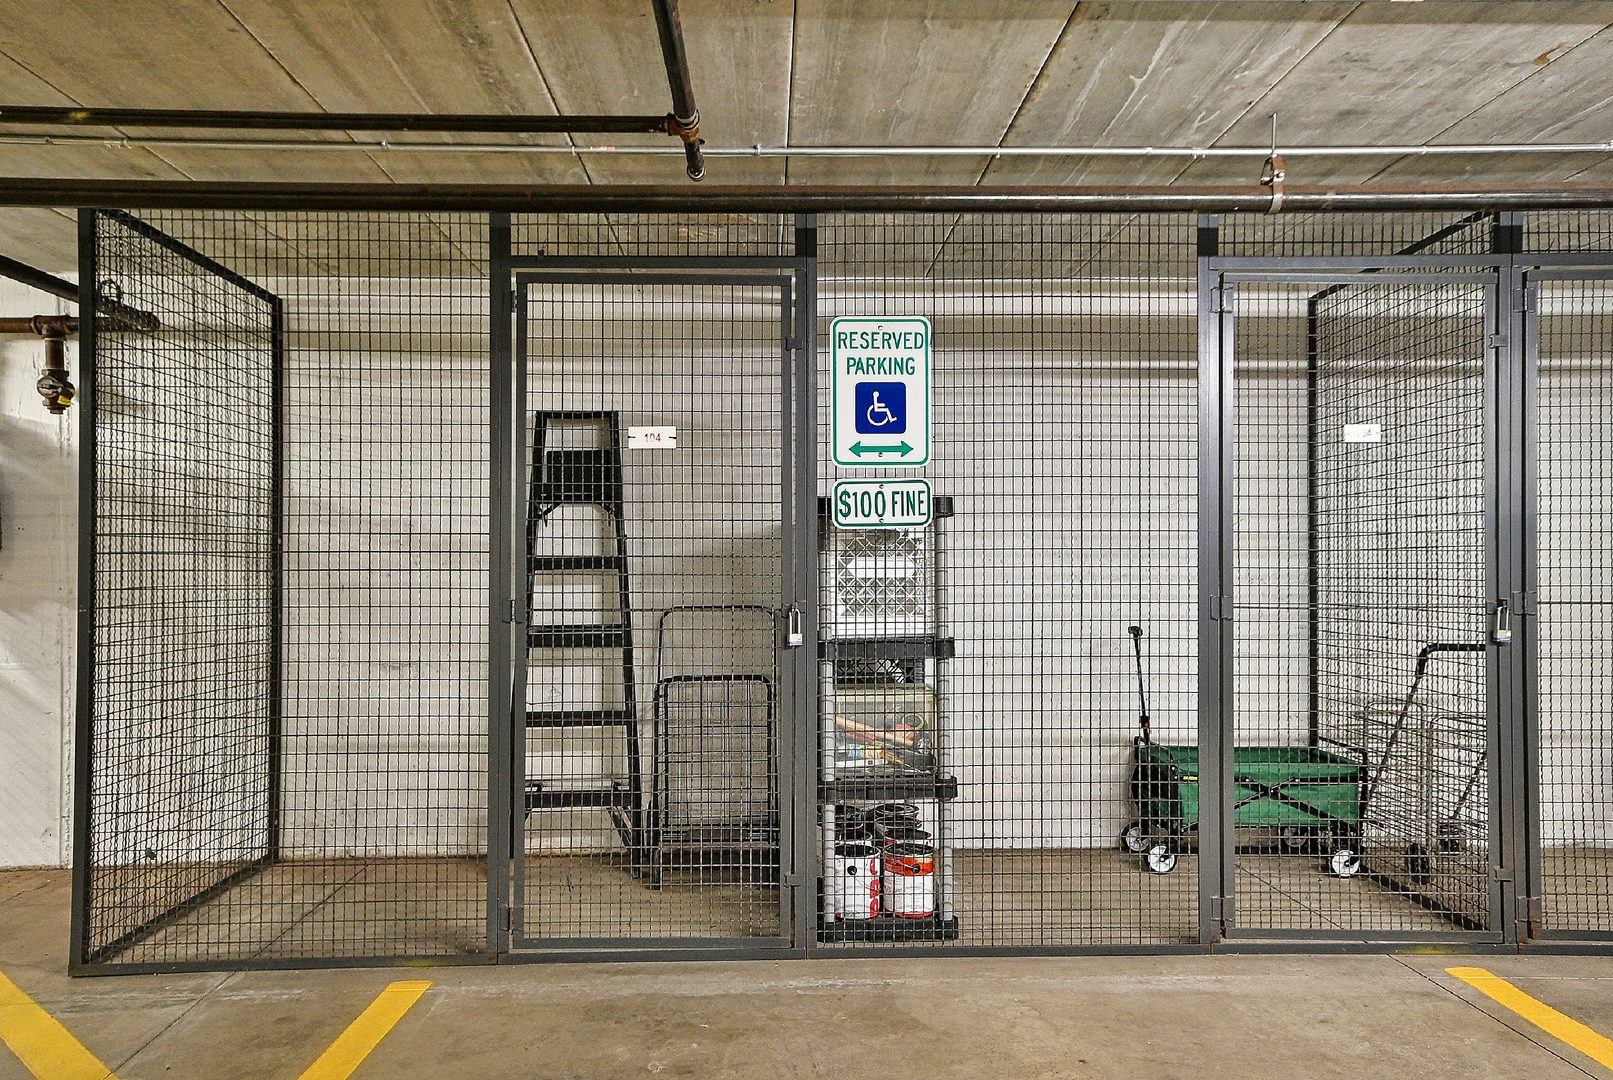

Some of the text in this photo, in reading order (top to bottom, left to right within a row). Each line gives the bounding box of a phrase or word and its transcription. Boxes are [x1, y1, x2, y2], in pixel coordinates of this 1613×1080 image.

[838, 332, 924, 349] RESERVED
[846, 357, 915, 375] PARKING
[644, 432, 662, 443] 104
[839, 489, 926, 519] $100 FINE
